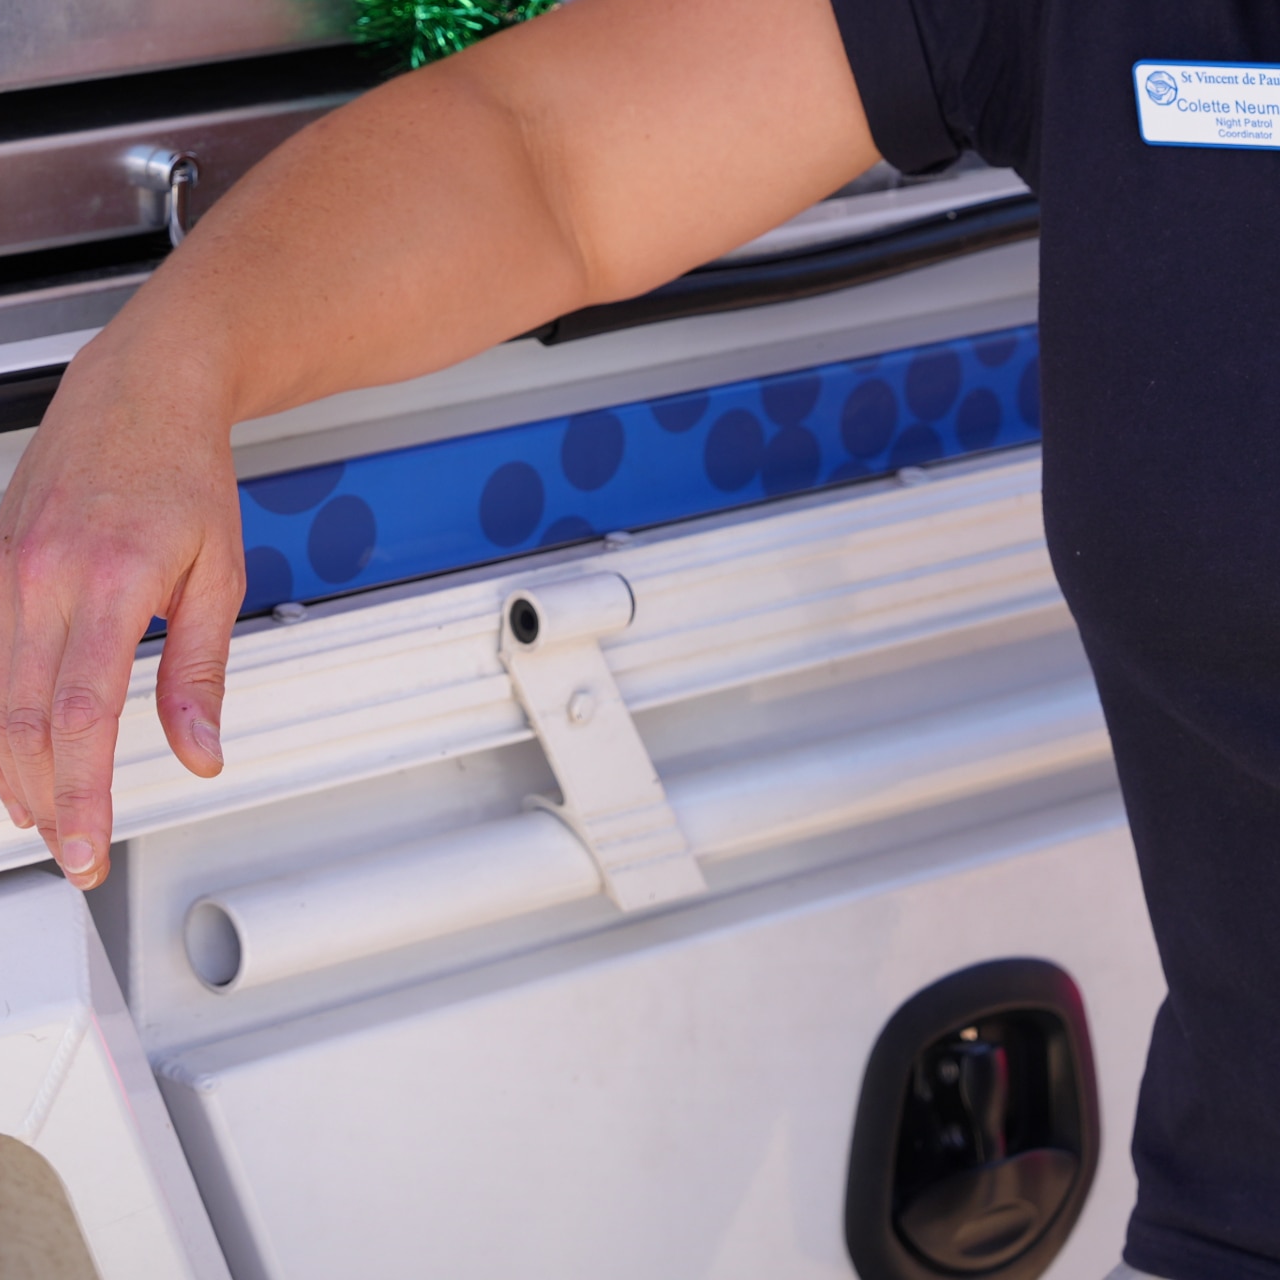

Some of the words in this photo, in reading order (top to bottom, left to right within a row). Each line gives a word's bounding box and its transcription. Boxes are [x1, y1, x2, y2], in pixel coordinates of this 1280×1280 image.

[1181, 71, 1192, 84] St
[1195, 71, 1239, 85] Vincent
[1242, 73, 1256, 86] de
[1177, 98, 1230, 113] Colette
[1215, 118, 1241, 129] Night
[1244, 118, 1273, 128] Patrol
[1218, 129, 1273, 139] Coordinator
